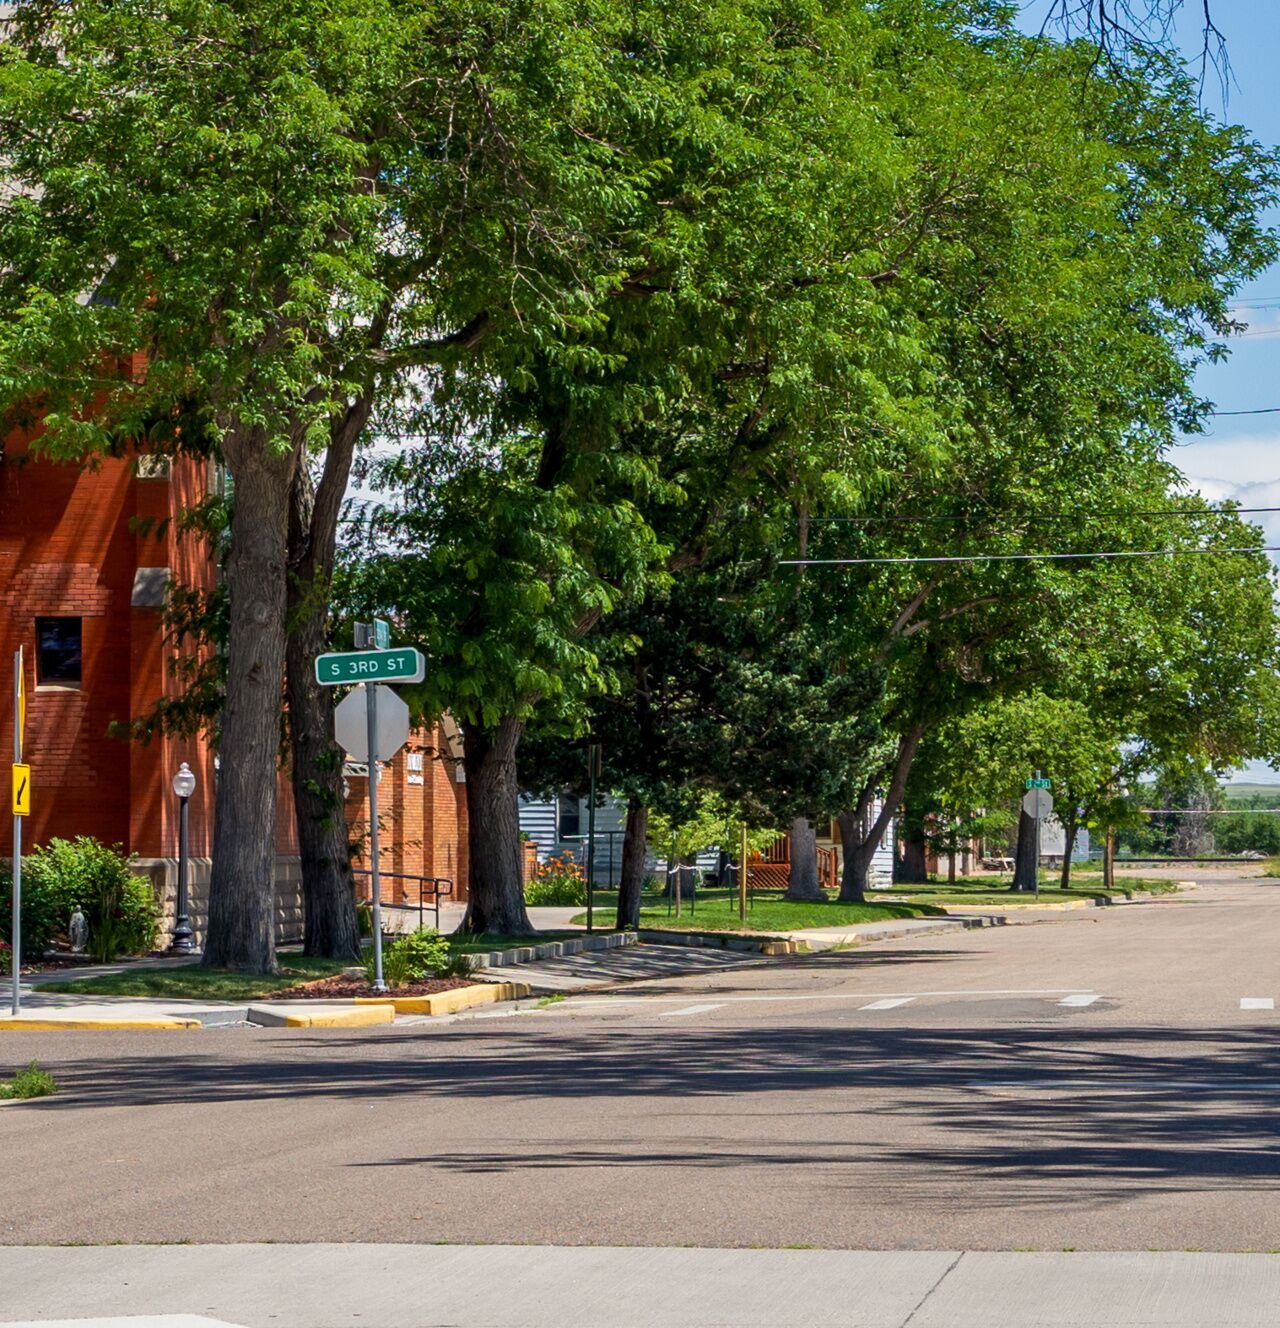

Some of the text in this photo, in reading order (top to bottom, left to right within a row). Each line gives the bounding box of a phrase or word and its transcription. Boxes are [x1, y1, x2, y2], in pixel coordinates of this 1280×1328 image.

[331, 658, 405, 676] S 3RD ST
